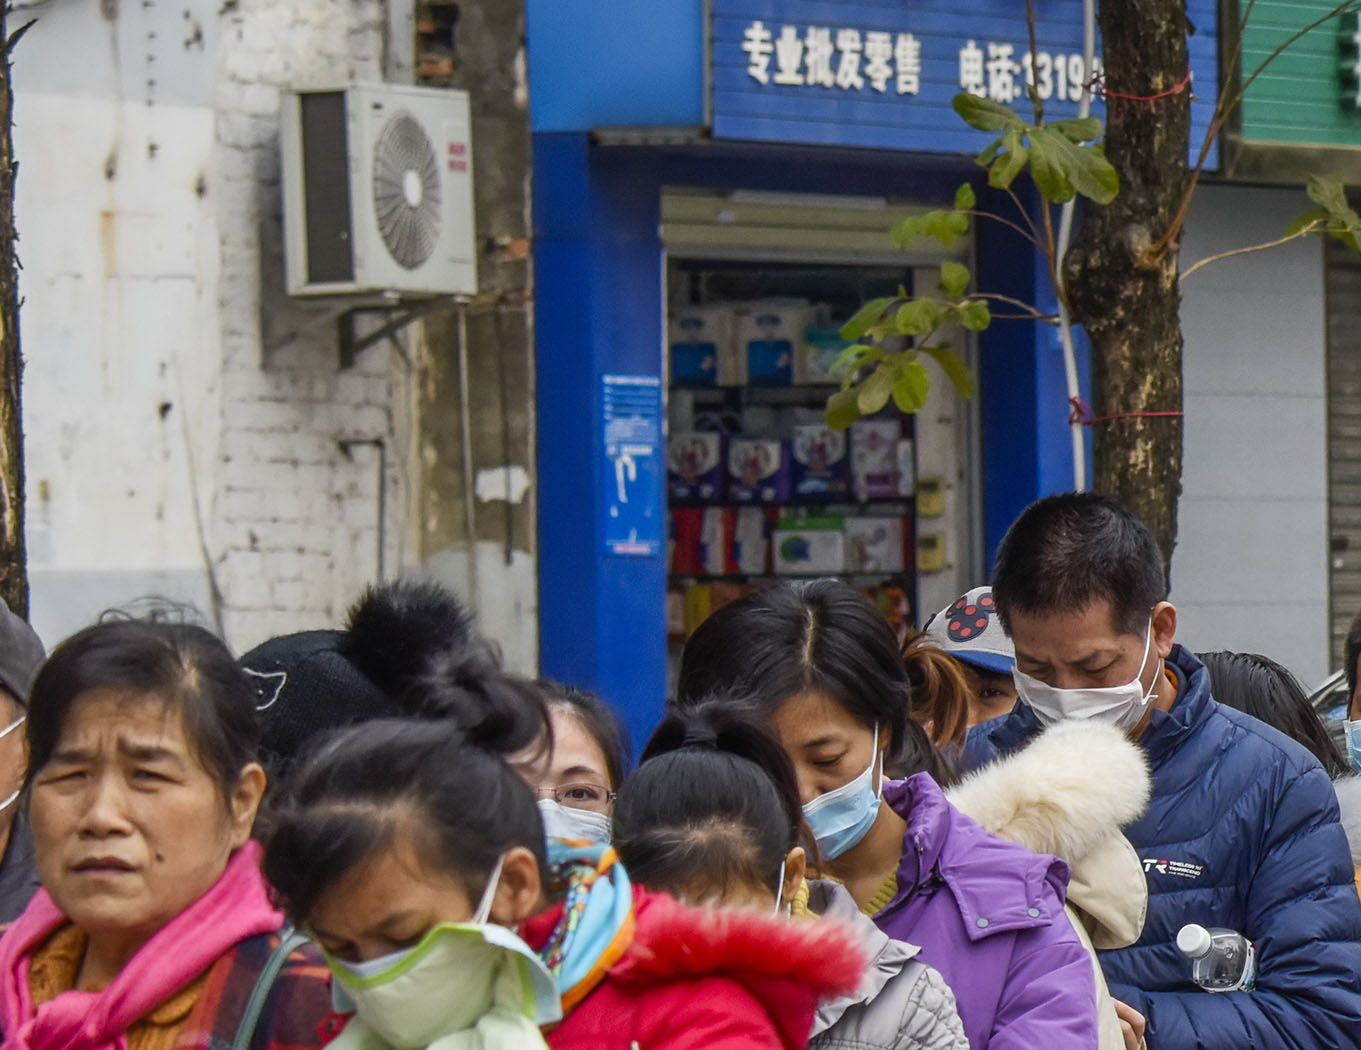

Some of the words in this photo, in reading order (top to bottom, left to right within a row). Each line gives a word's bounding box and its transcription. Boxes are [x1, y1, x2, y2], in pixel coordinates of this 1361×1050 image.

[742, 20, 922, 95] 专业批发零售
